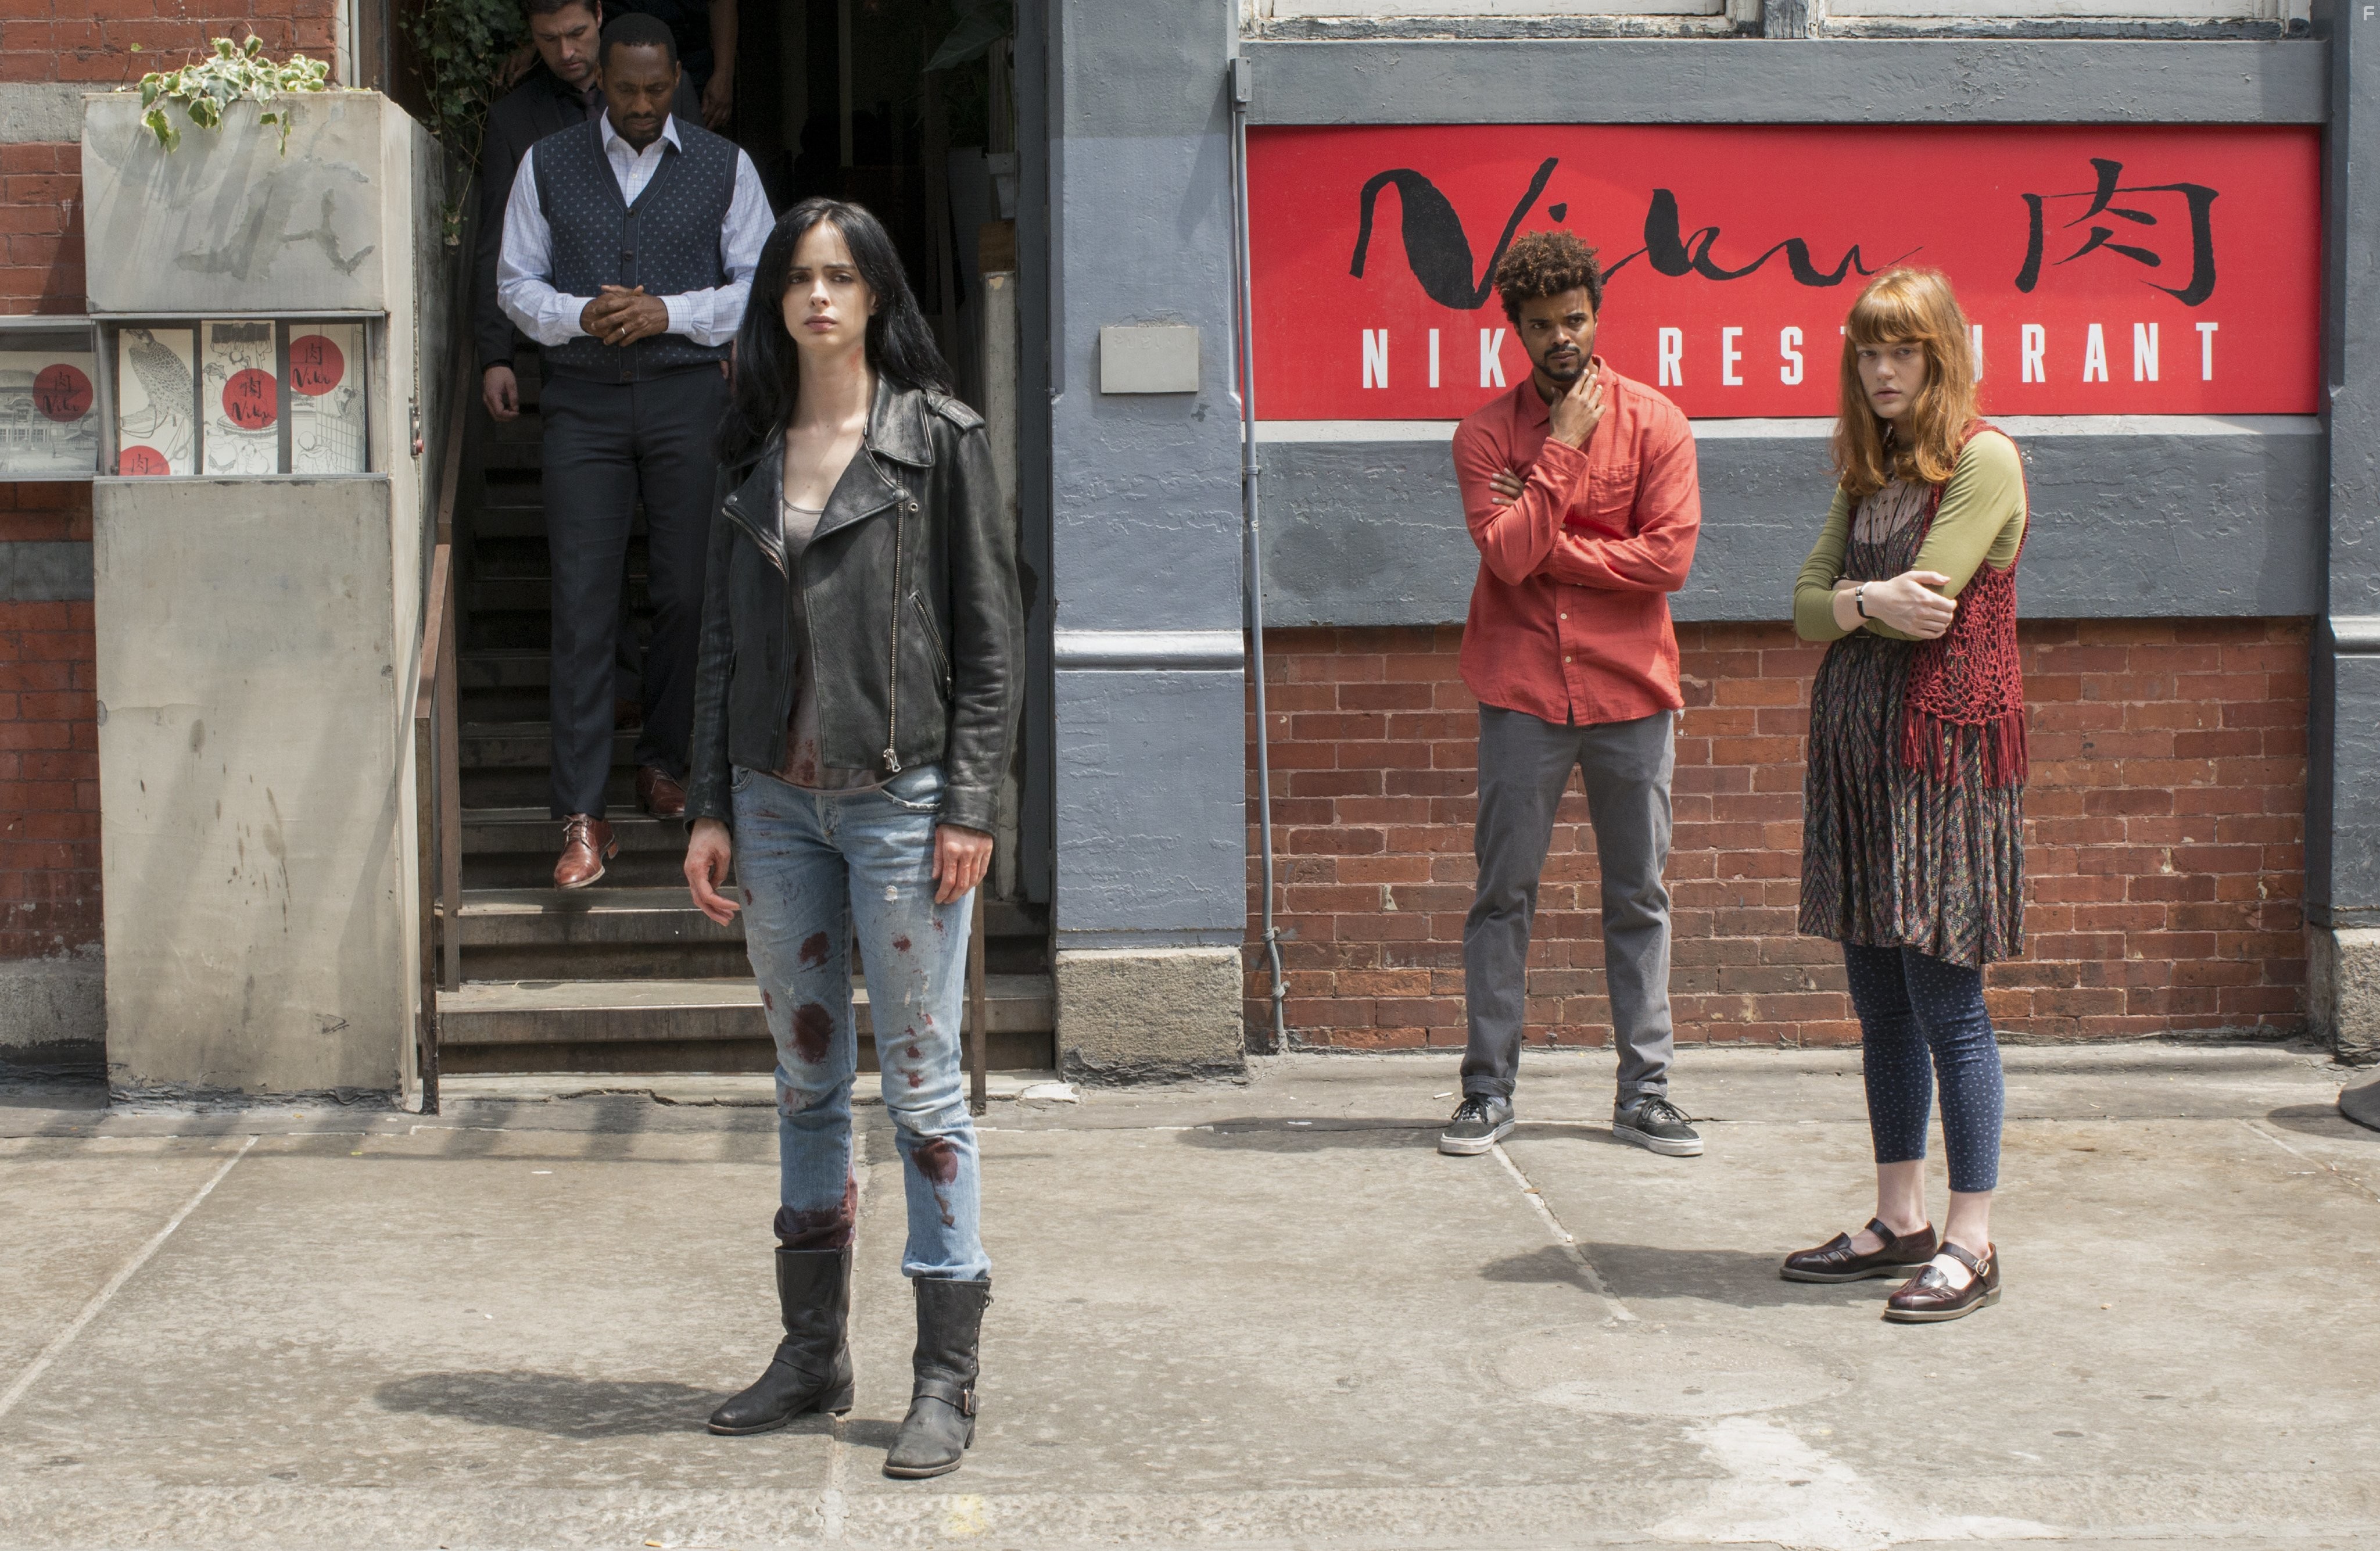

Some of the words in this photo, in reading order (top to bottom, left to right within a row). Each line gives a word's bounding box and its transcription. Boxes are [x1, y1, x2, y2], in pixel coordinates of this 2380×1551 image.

[1350, 157, 1923, 310] Nku
[2015, 158, 2220, 307] 肉
[1363, 328, 1507, 389] NIK
[1659, 322, 2219, 386] RESRANT
